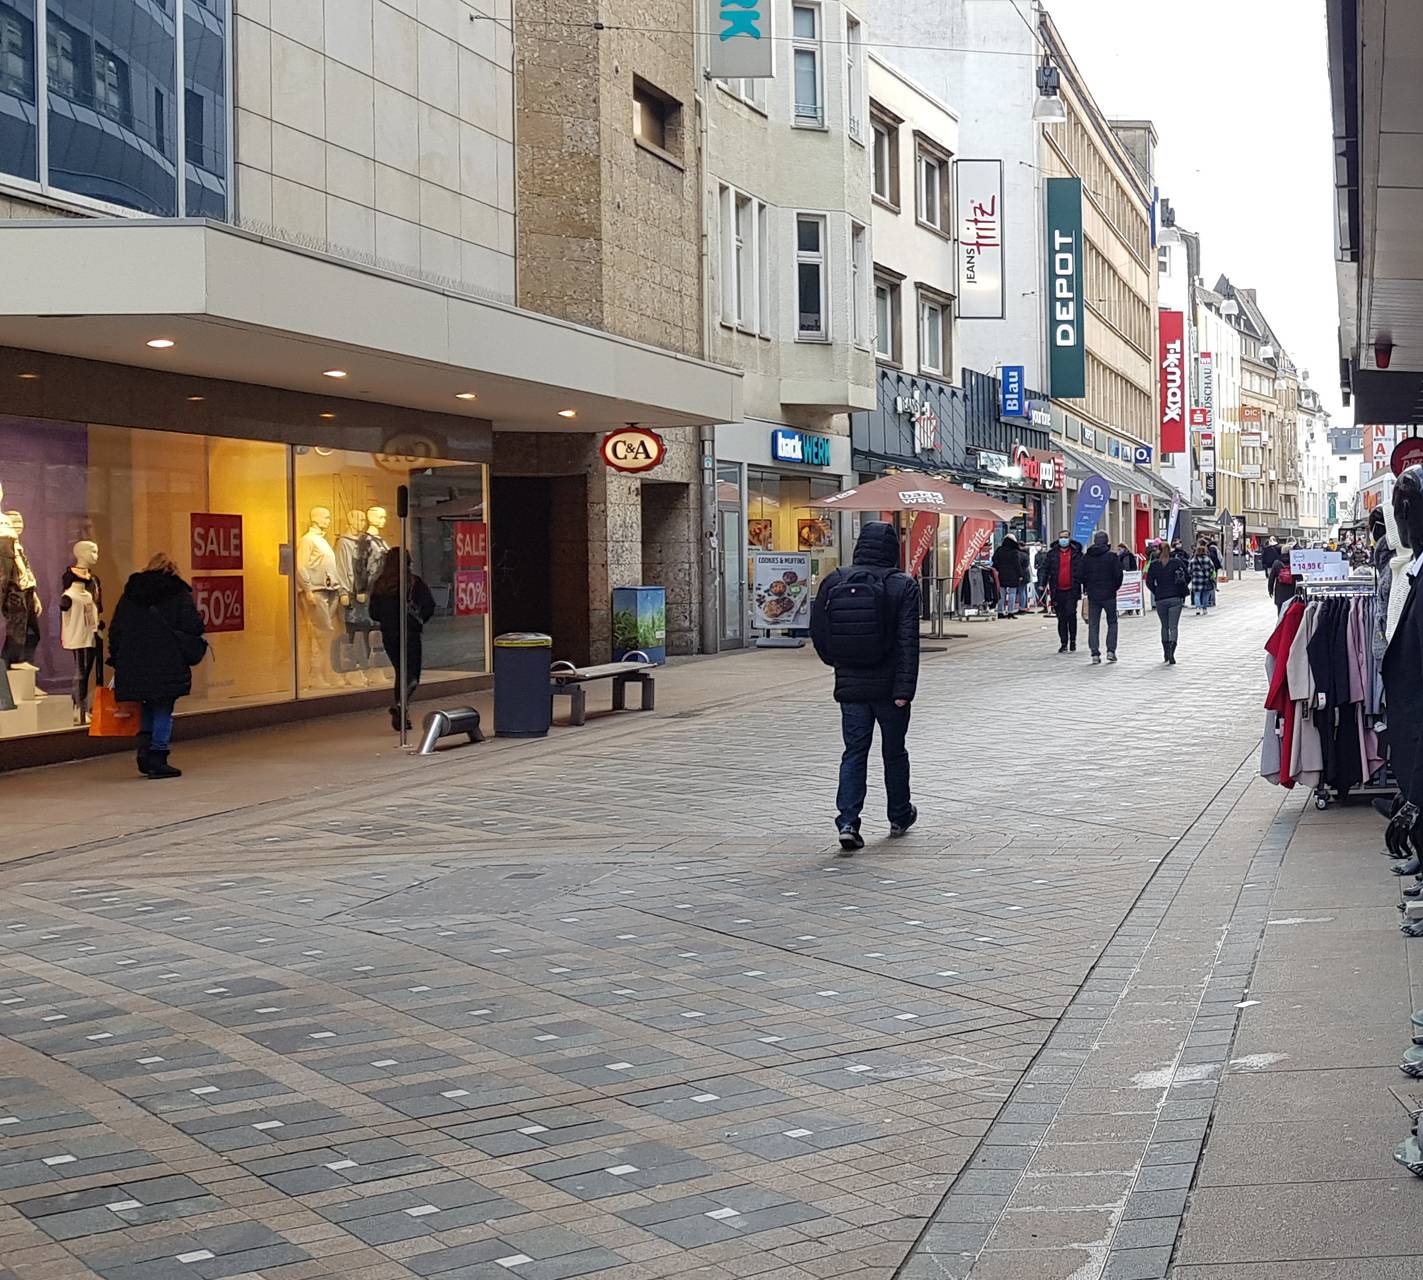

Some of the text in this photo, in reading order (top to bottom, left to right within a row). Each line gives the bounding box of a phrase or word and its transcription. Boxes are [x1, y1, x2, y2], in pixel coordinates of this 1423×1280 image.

[719, 0, 761, 41] K
[960, 195, 1000, 284] JEANS fritz
[1054, 229, 1075, 346] DEPOT
[1005, 371, 1019, 411] Blau
[611, 439, 653, 460] C&A
[193, 526, 241, 557] SALE
[456, 532, 487, 556] SALE
[196, 590, 241, 626] 50%
[457, 582, 487, 610] 50%
